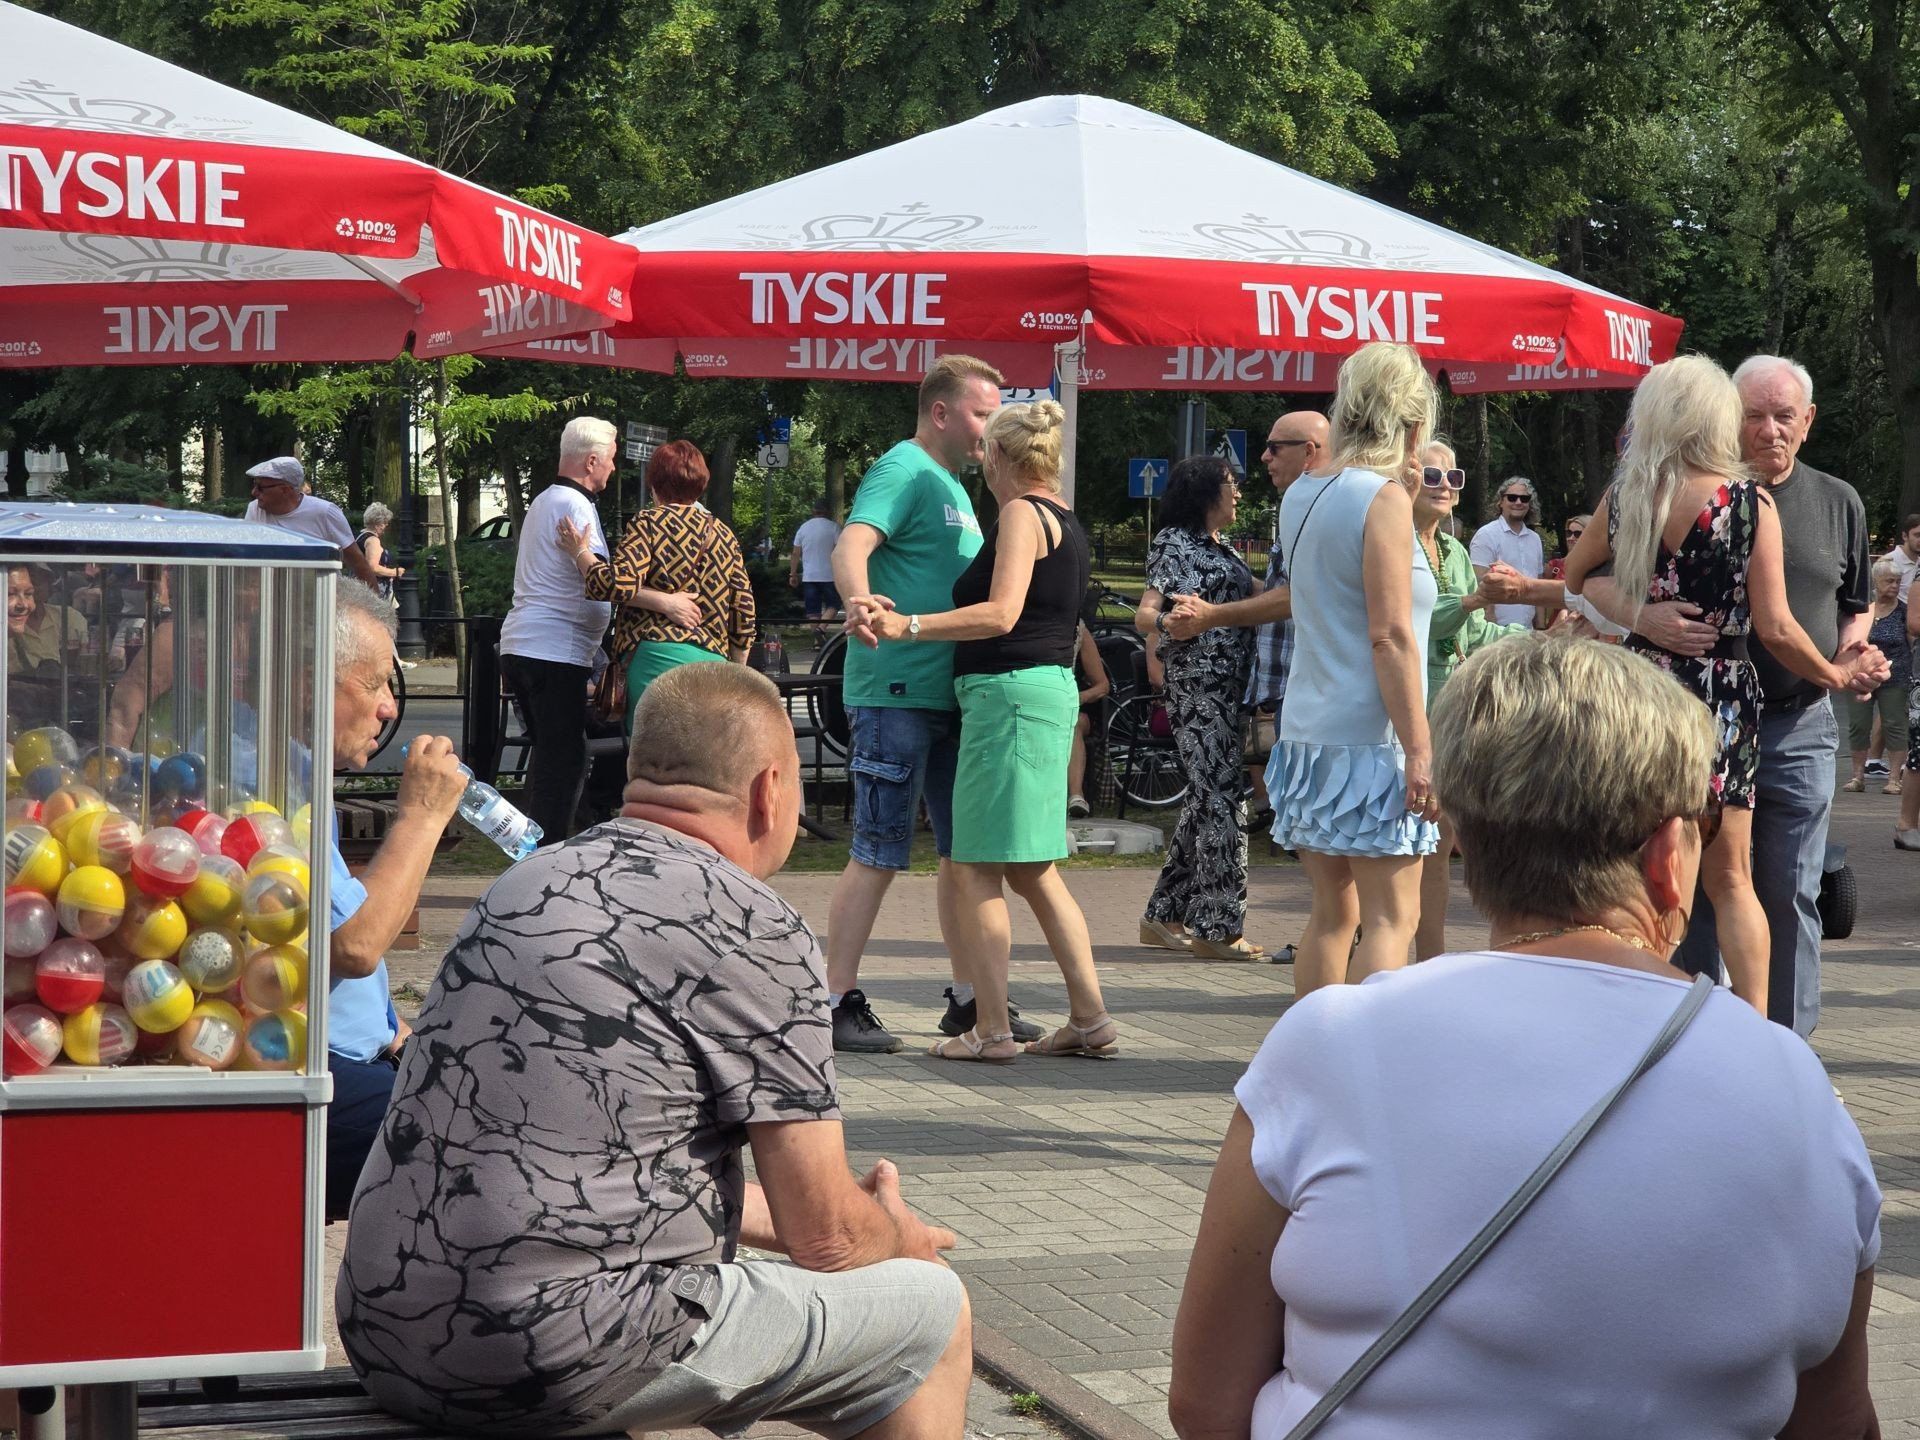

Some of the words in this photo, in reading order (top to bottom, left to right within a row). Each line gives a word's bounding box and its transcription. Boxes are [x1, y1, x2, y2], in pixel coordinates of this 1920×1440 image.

[356, 219, 397, 236] 100%
[495, 206, 582, 290] TYSKIE
[739, 272, 947, 325] TYSKIE
[1039, 313, 1078, 325] 100%
[1241, 282, 1445, 345] TYSKIE
[1526, 335, 1556, 348] 100%
[1604, 309, 1654, 367] TYSKIE
